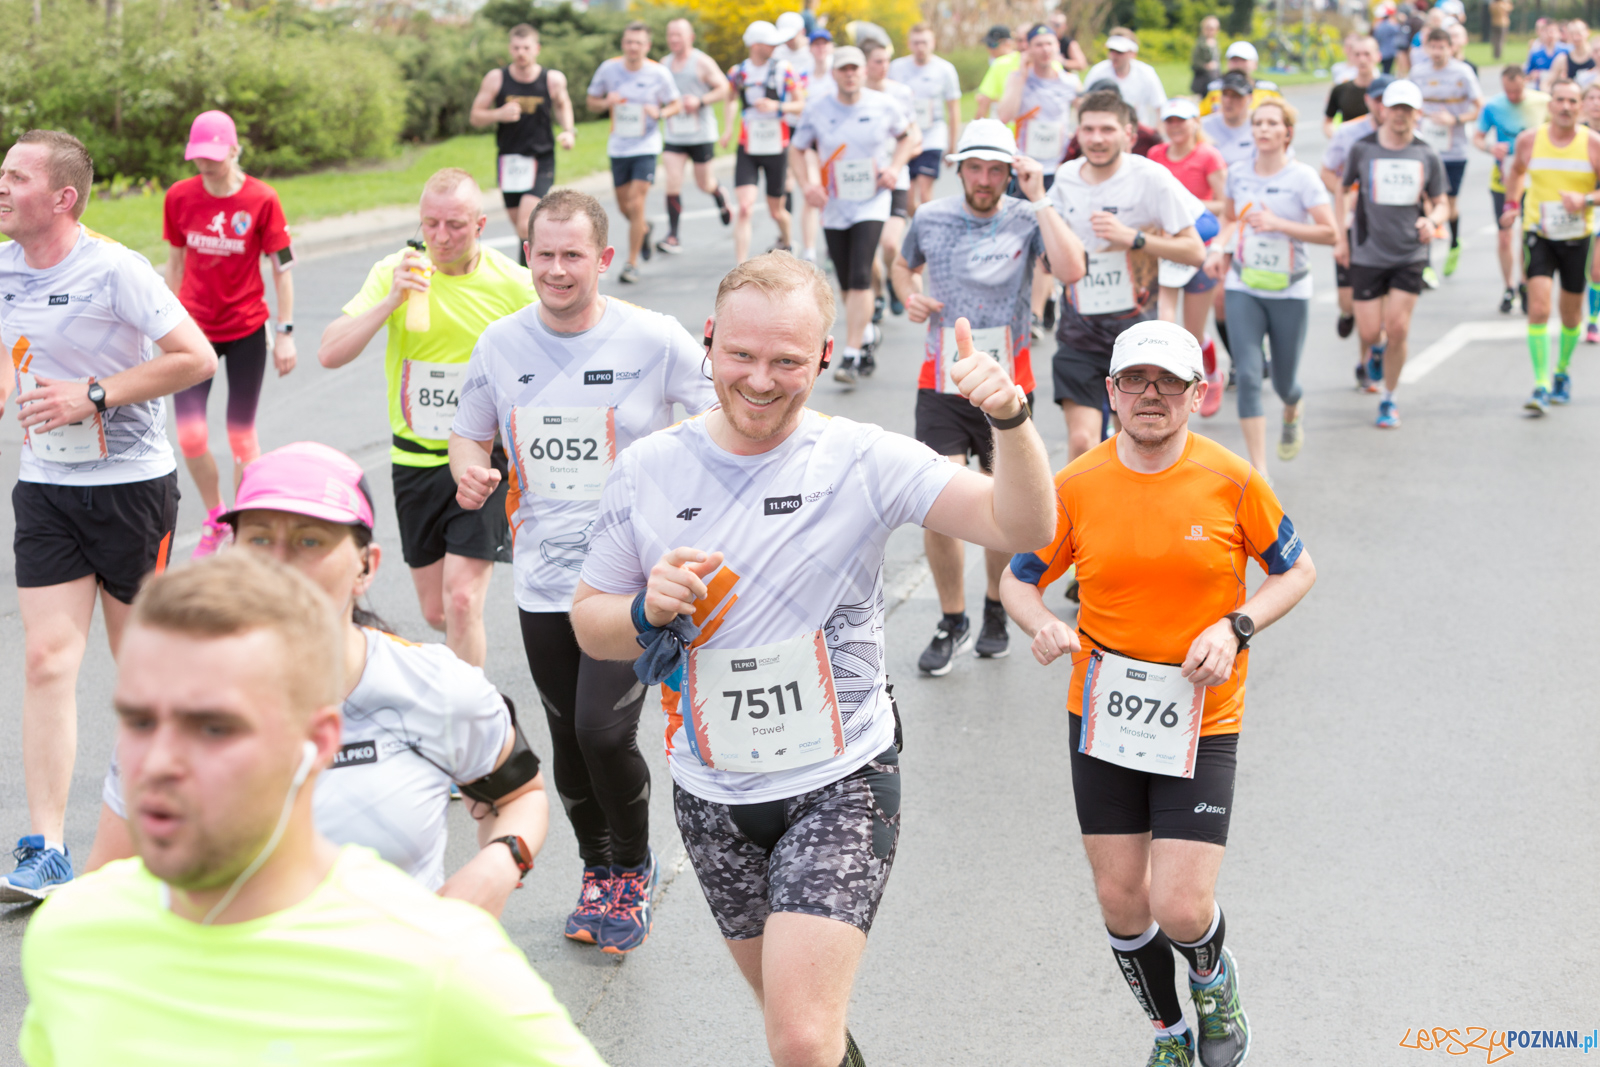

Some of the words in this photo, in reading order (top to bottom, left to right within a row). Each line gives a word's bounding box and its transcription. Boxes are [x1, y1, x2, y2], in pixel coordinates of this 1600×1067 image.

[517, 373, 536, 384] 4F
[529, 437, 599, 461] 6052
[549, 465, 579, 474] Bartosz
[676, 507, 703, 521] 4F
[722, 680, 803, 721] 7511
[1107, 690, 1179, 728] 8976
[752, 723, 785, 736] Paweł
[1119, 725, 1157, 740] Mirosław
